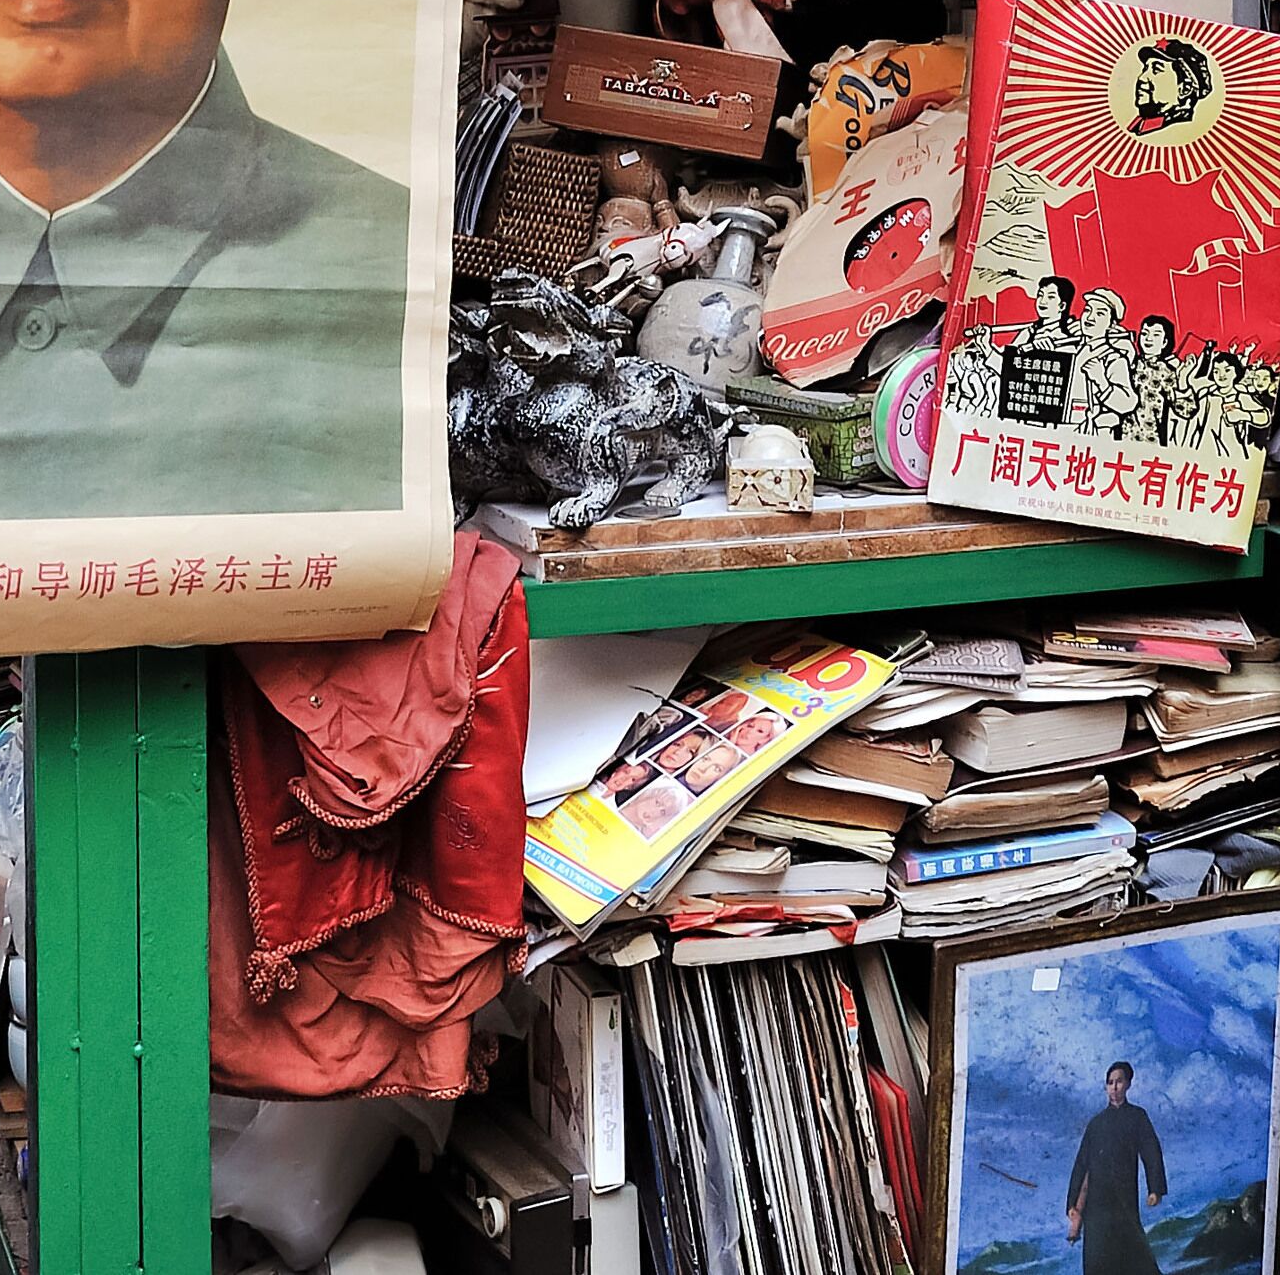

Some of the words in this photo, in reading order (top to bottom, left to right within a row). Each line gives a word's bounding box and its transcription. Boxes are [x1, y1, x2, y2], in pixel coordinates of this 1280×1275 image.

[604, 77, 718, 105] TABACALEA
[835, 75, 876, 160] GOO
[766, 327, 850, 362] Queen
[899, 366, 938, 437] COL-R
[951, 429, 1246, 518] 广阔天地大有作为
